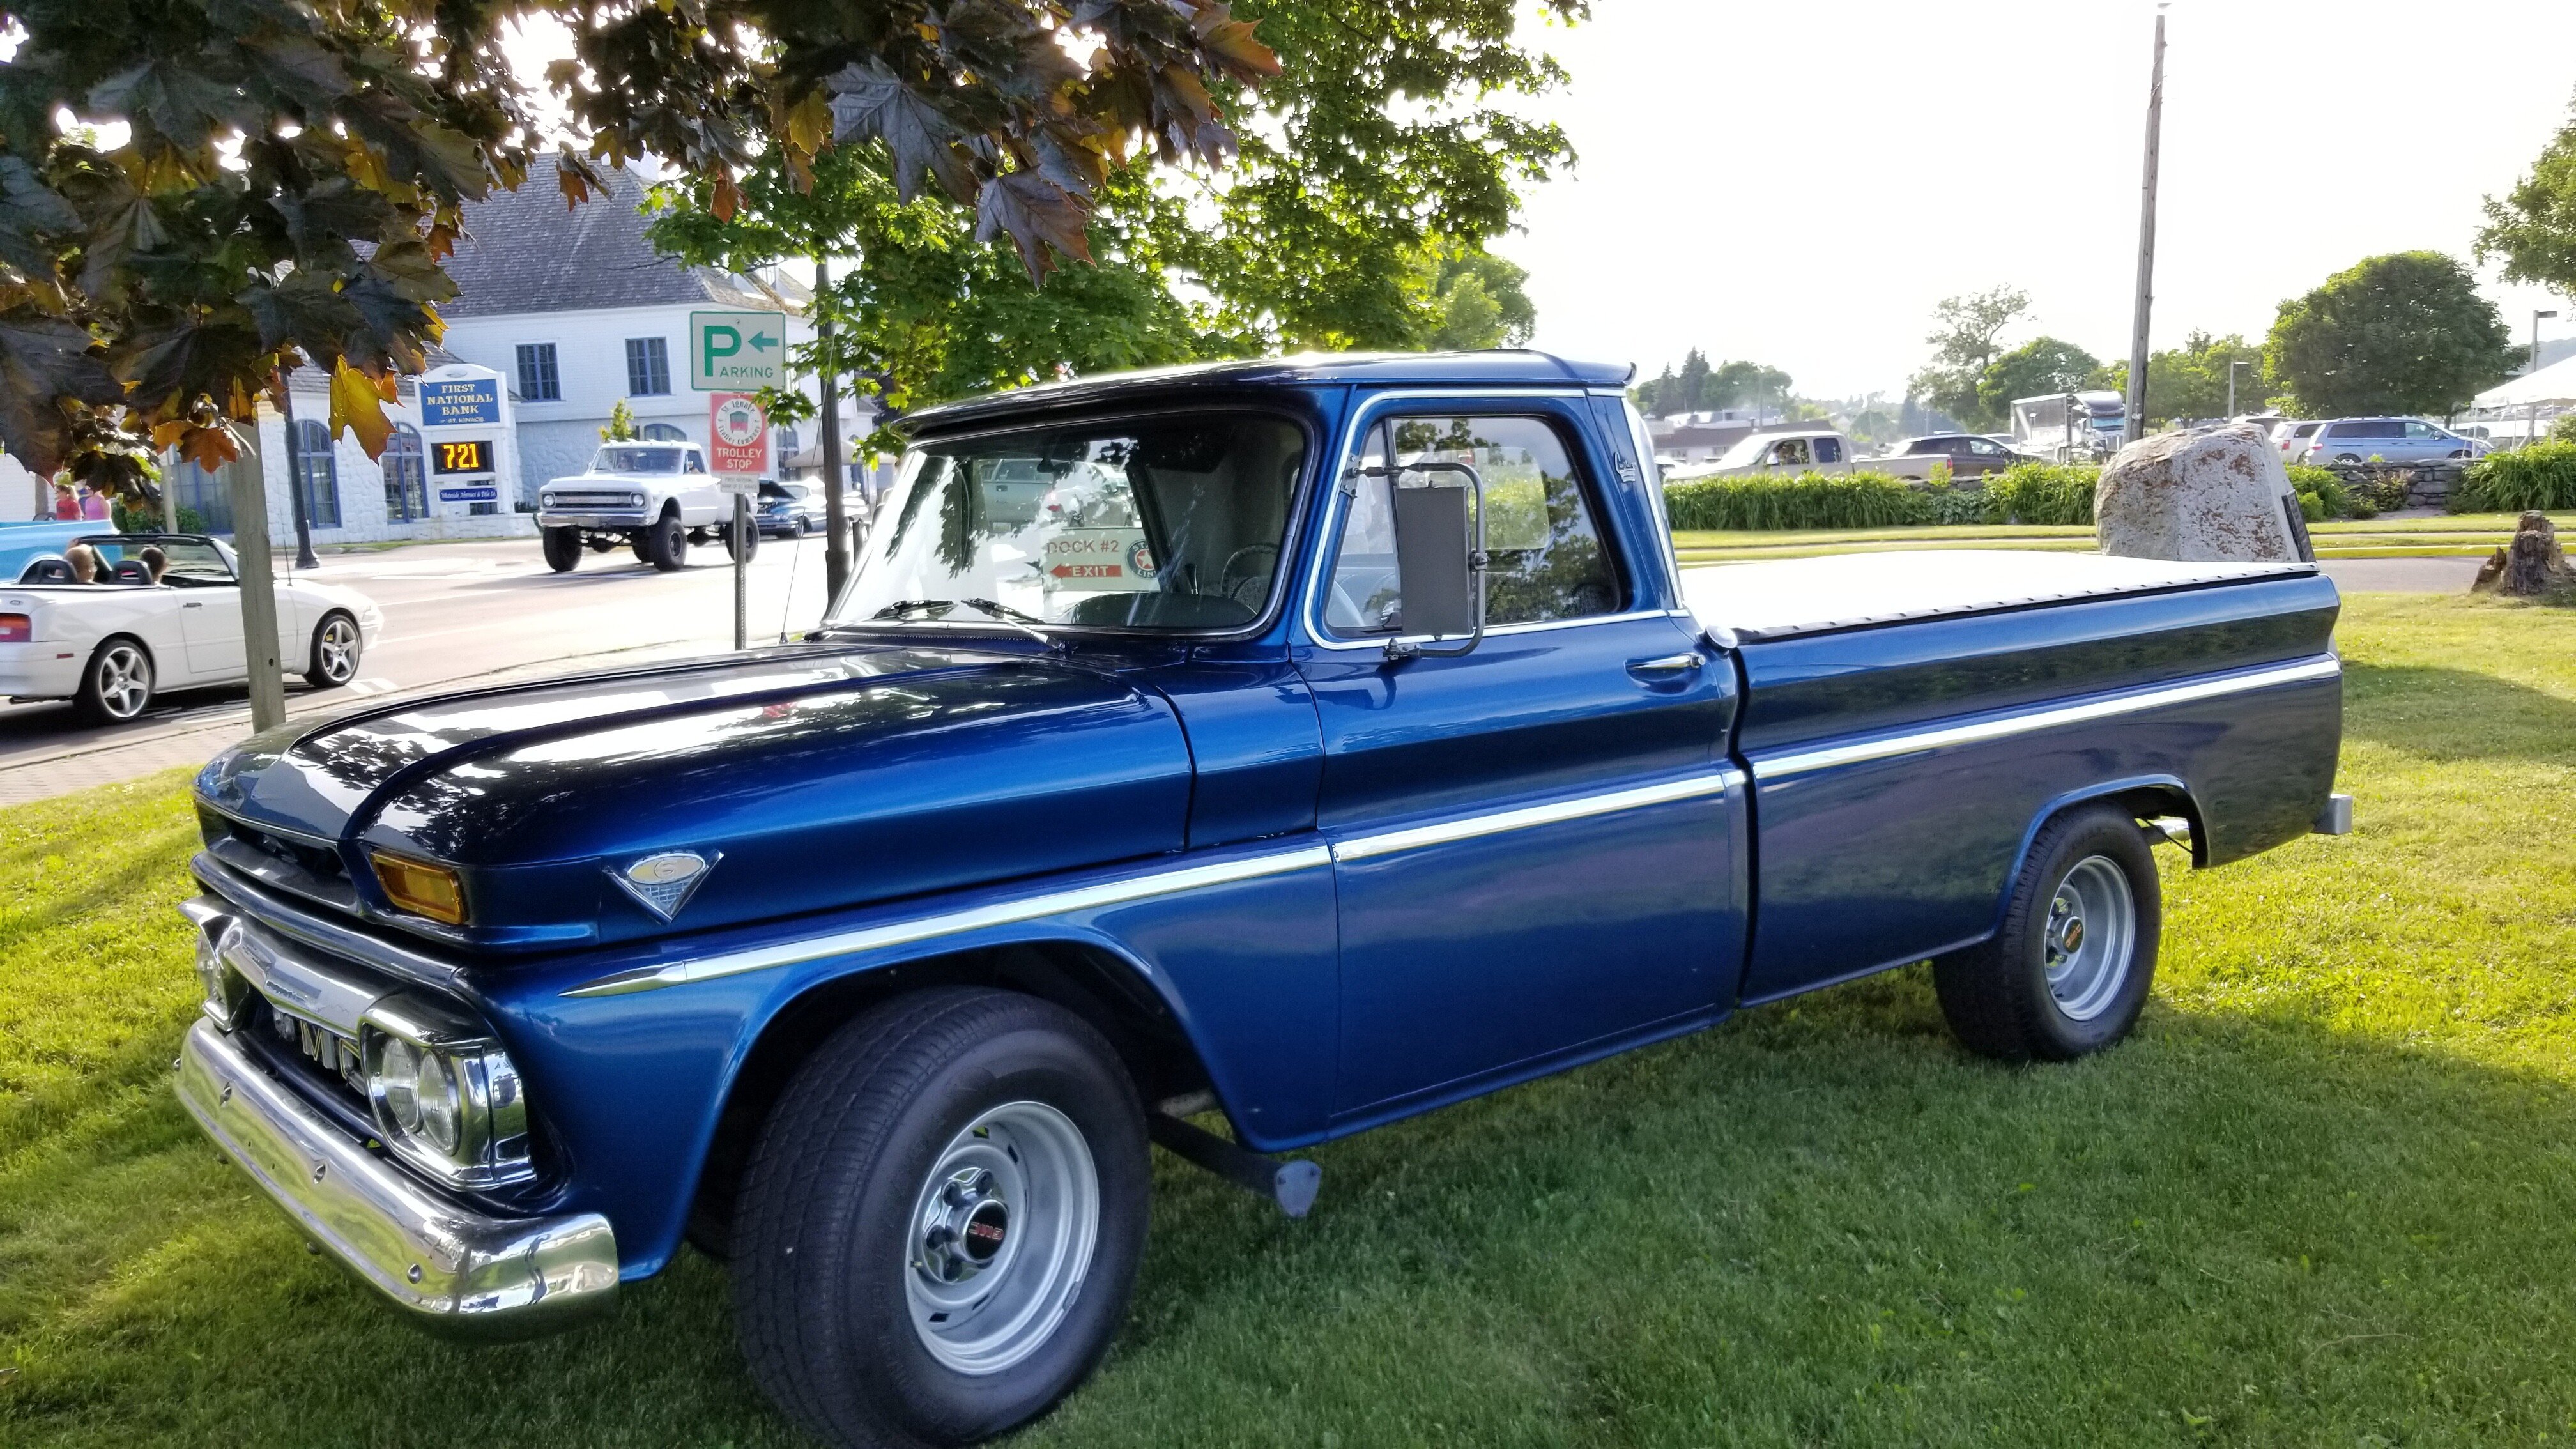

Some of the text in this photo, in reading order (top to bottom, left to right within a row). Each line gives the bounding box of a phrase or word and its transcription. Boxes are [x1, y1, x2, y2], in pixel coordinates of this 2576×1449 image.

[441, 383, 475, 394] FIRST
[427, 394, 493, 405] NATIONAL
[442, 405, 479, 416] BANK
[718, 425, 735, 444] Trolley
[717, 448, 762, 458] TROLLEY
[727, 459, 753, 469] STOP
[1047, 540, 1119, 553] DOCK #2
[1072, 566, 1109, 577] EXIT
[967, 1222, 1005, 1241] GMC
